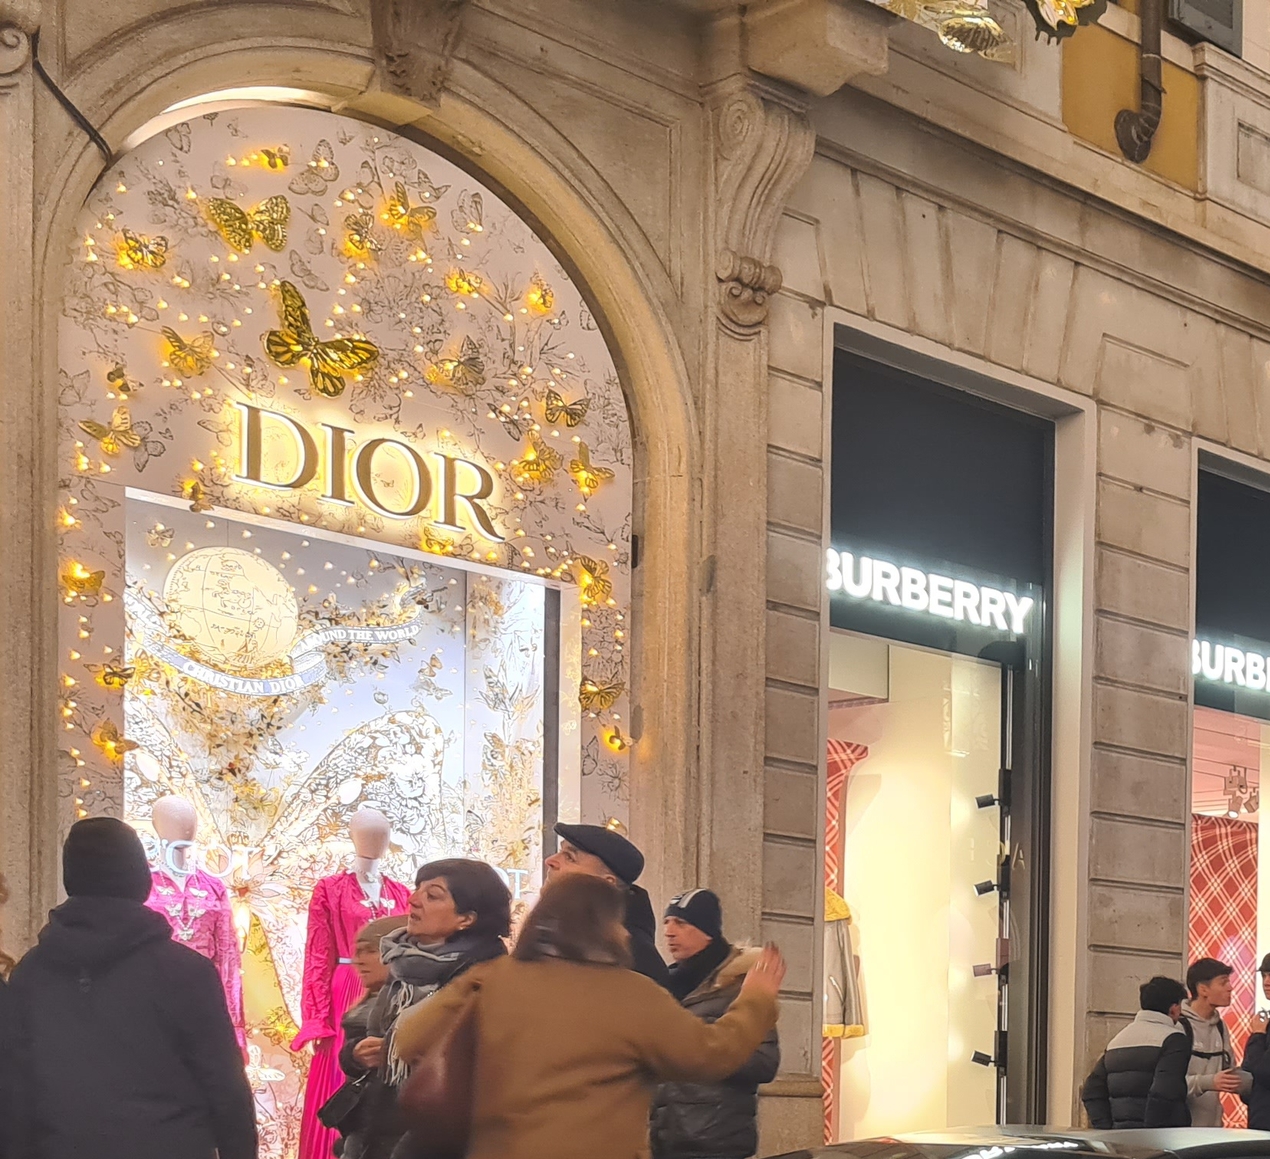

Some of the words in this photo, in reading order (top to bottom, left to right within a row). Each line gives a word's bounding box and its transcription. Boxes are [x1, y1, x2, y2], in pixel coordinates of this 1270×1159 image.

[232, 401, 505, 543] DIOR
[347, 630, 374, 641] THE
[375, 624, 419, 641] WORLD
